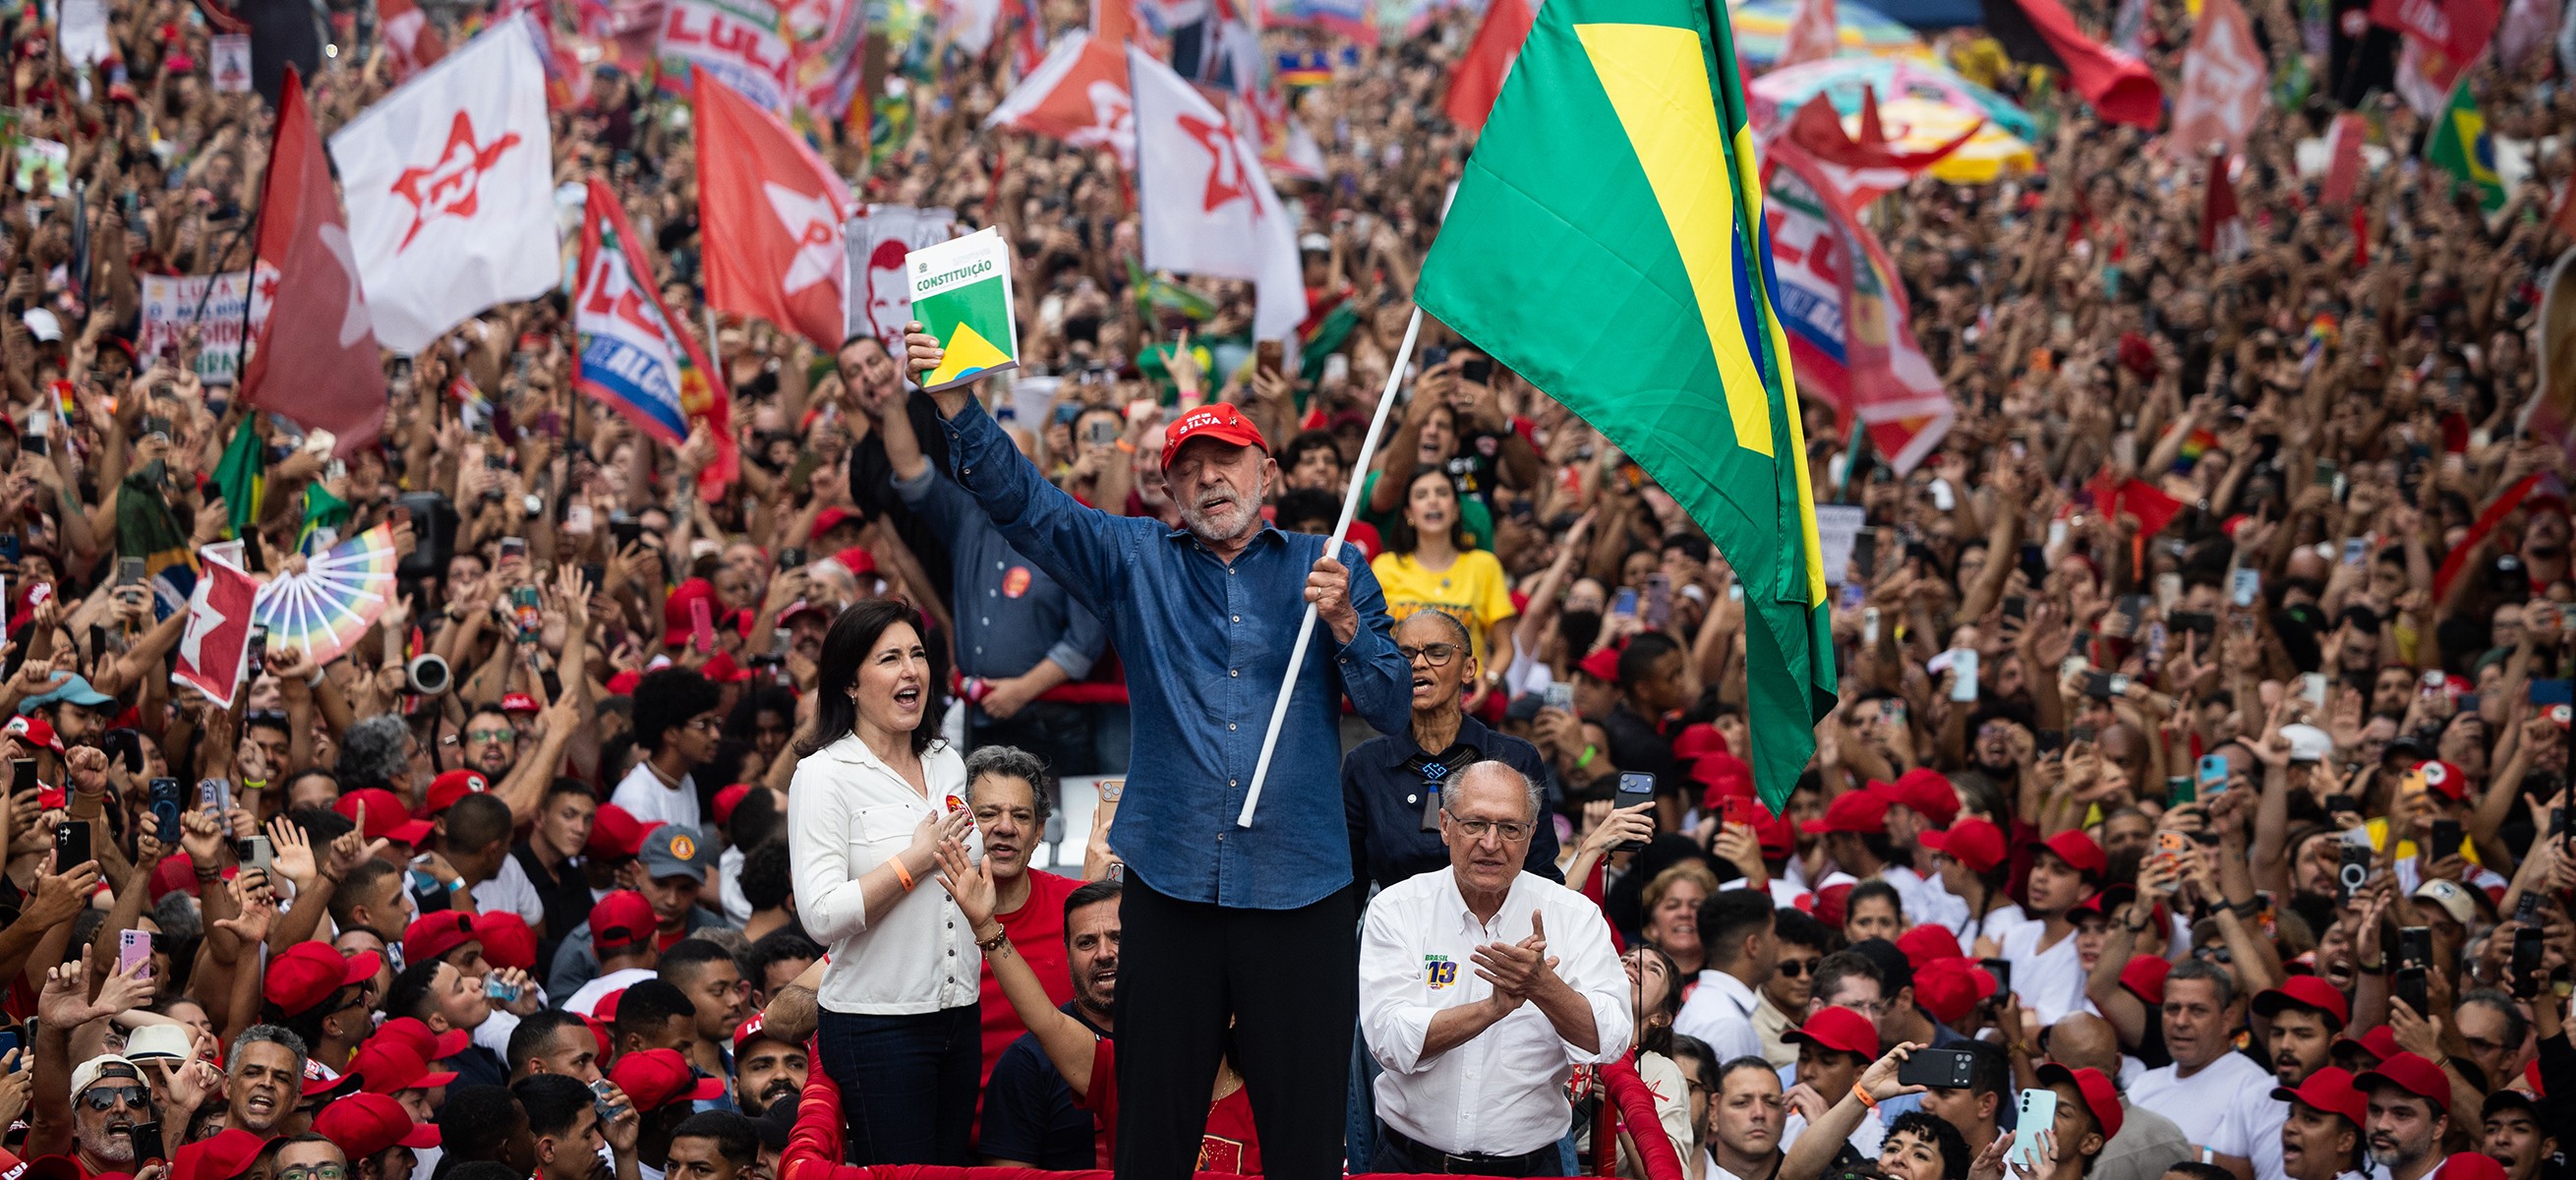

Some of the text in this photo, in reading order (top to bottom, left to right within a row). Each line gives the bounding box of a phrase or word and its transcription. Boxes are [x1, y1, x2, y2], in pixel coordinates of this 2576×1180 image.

[667, 7, 790, 90] LUL
[916, 260, 992, 292] CONSTITUIÇÃO
[1180, 416, 1222, 435] SILVA
[1429, 961, 1457, 983] 13
